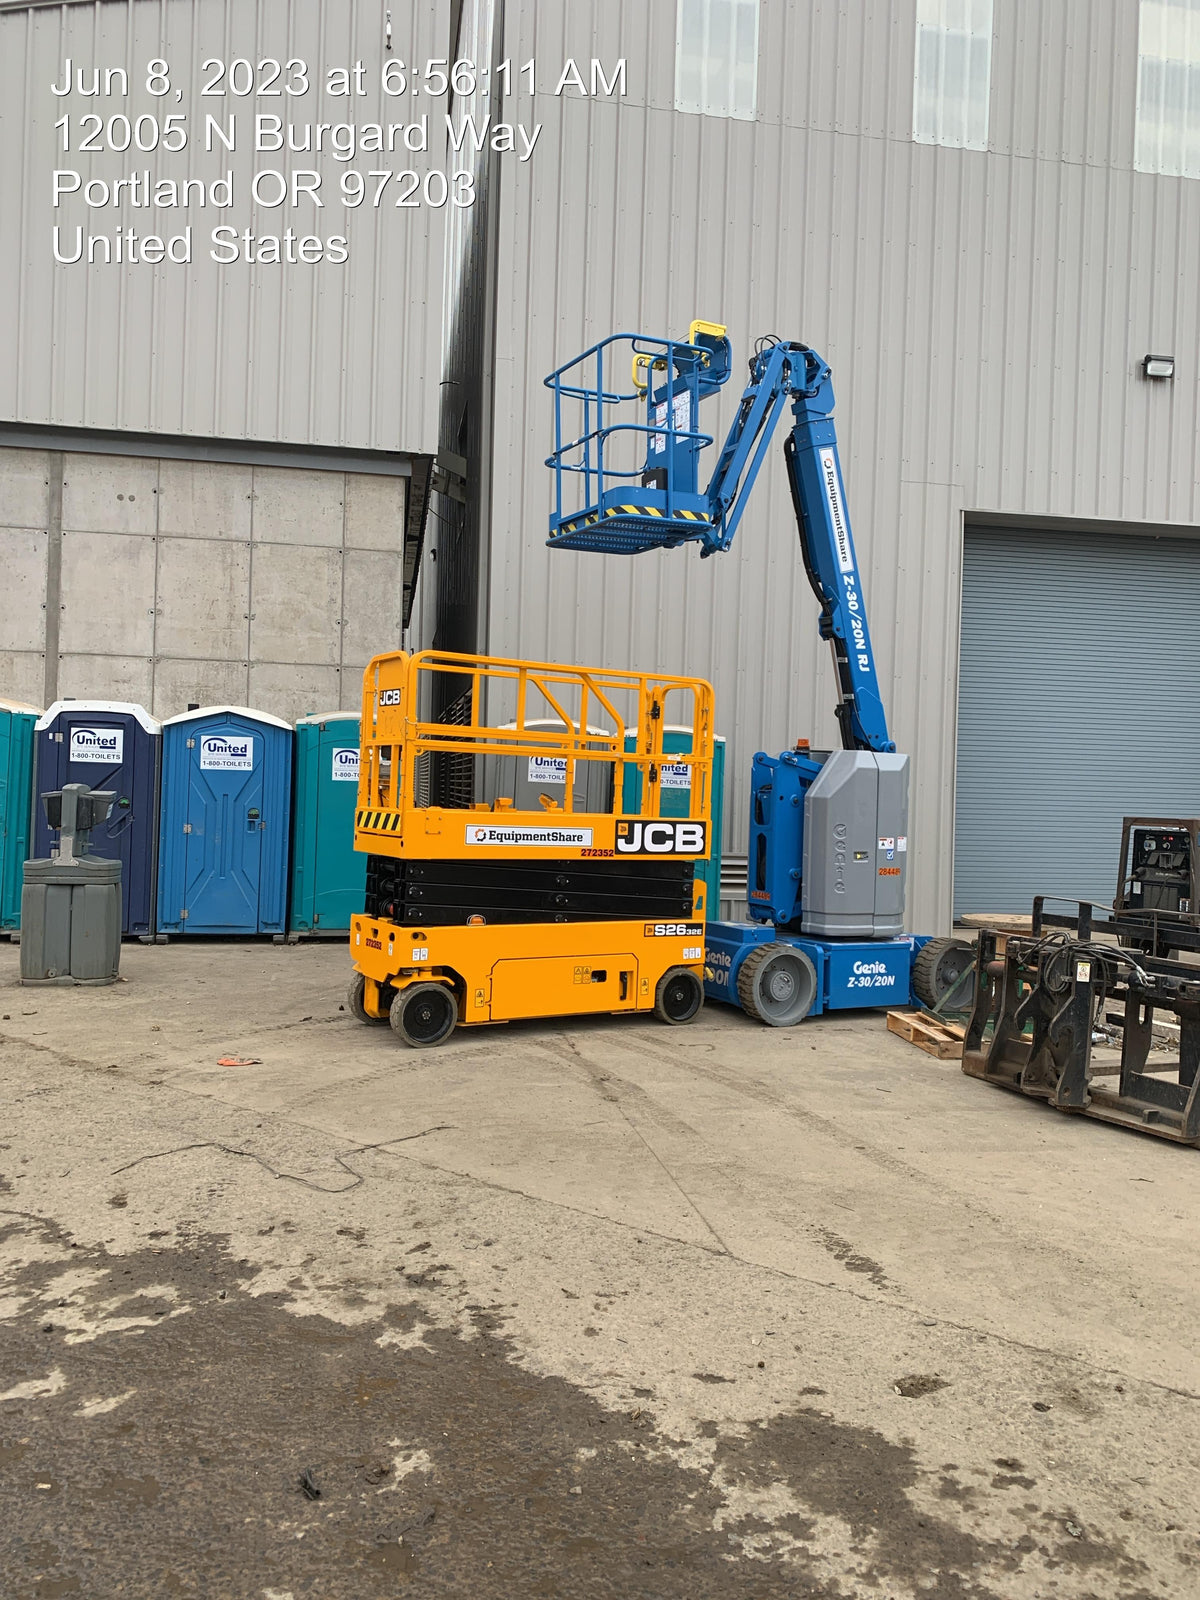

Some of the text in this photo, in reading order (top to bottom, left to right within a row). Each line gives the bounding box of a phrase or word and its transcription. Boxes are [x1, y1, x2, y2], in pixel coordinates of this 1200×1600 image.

[827, 471, 848, 563] EquipmentShare
[843, 575, 871, 673] Z-30/20N RJ
[379, 689, 400, 706] JCB
[77, 734, 117, 746] United
[208, 742, 247, 754] United
[71, 752, 121, 760] 1-800-TOILETS
[339, 754, 360, 765] Uni
[203, 760, 252, 768] 1-800-TOILETS
[661, 764, 689, 773] nited
[530, 773, 566, 781] 1-800-TOILE
[488, 830, 584, 843] EquipmentShare
[617, 822, 705, 853] JCB
[580, 848, 615, 858] 272352
[853, 960, 887, 975] Genie
[847, 974, 896, 988] Z-30/20N
